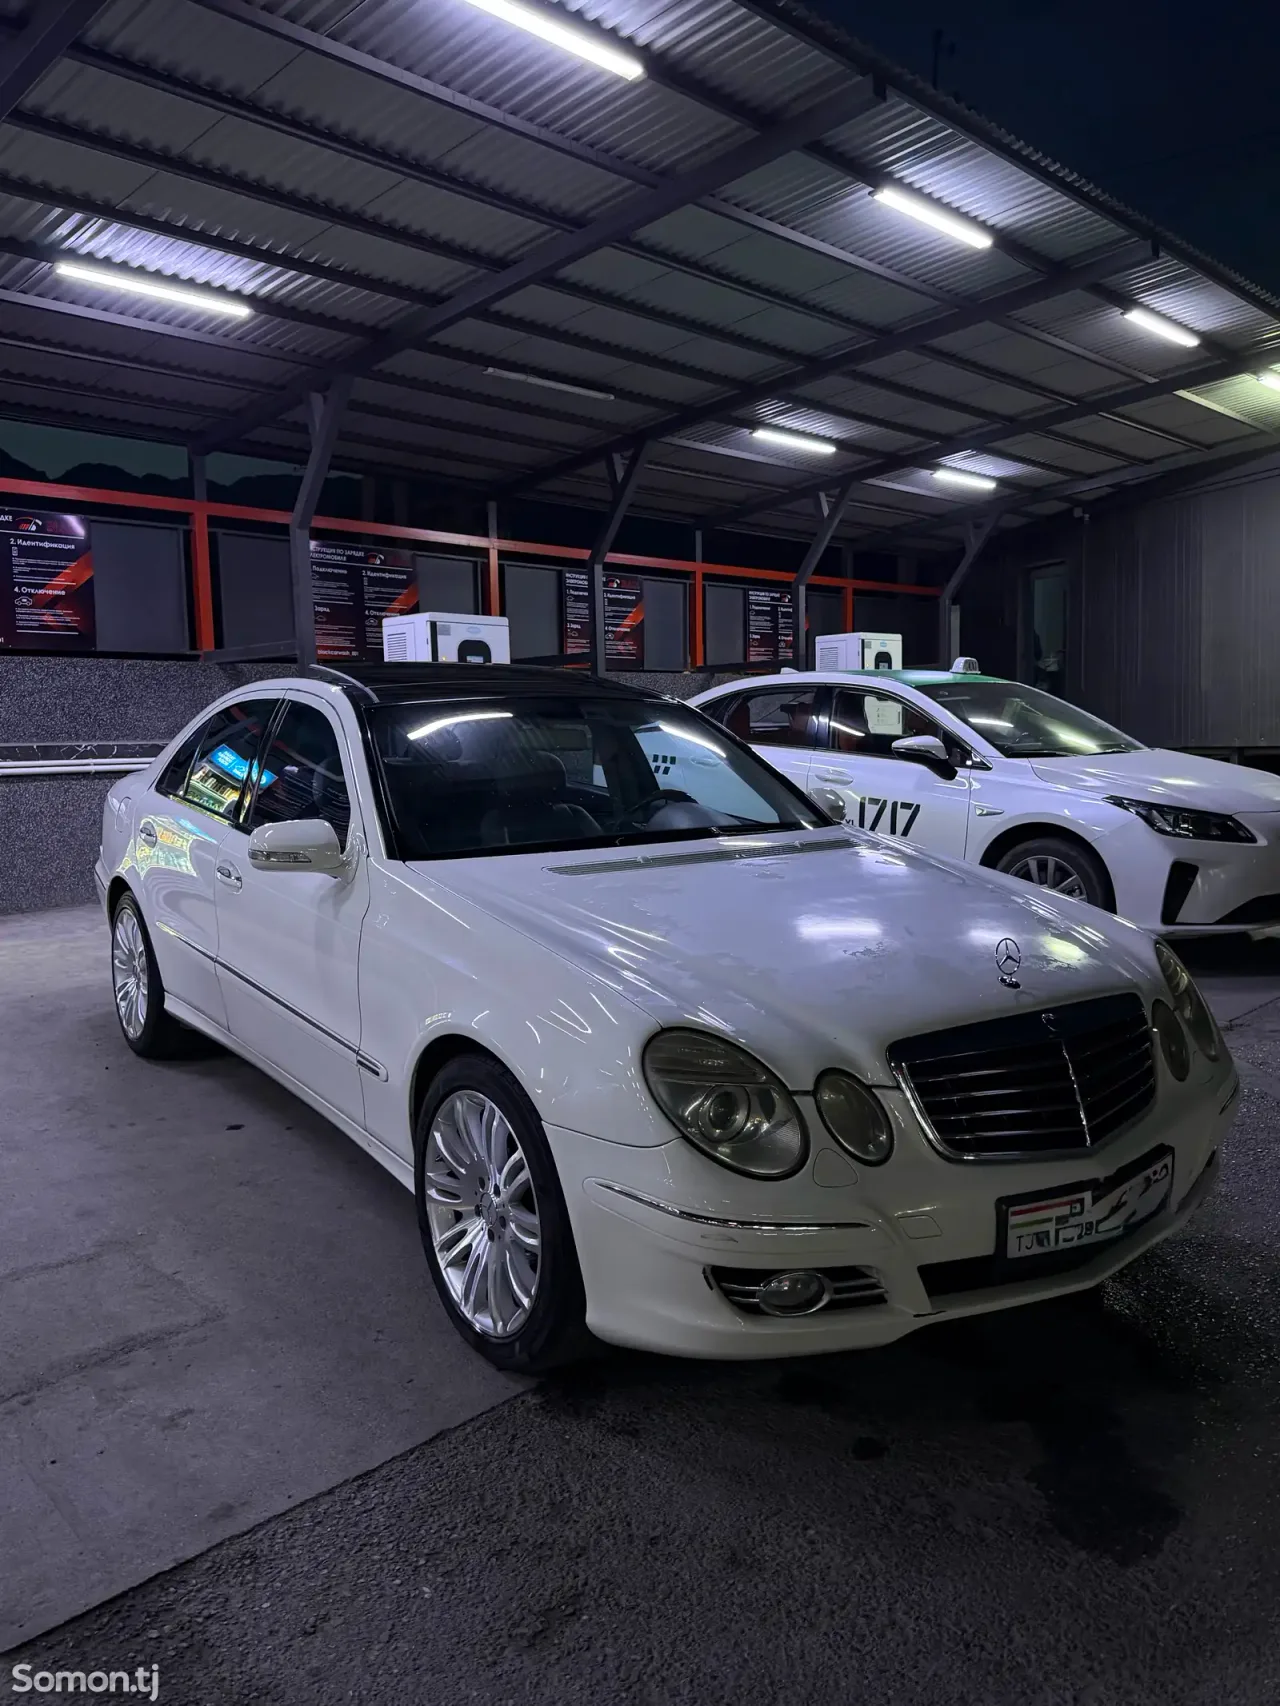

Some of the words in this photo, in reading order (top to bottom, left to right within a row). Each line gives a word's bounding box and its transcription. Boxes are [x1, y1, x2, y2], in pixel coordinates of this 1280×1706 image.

[17, 538, 75, 550] Идентификация
[21, 586, 66, 596] Отключение
[858, 796, 921, 837] 1717
